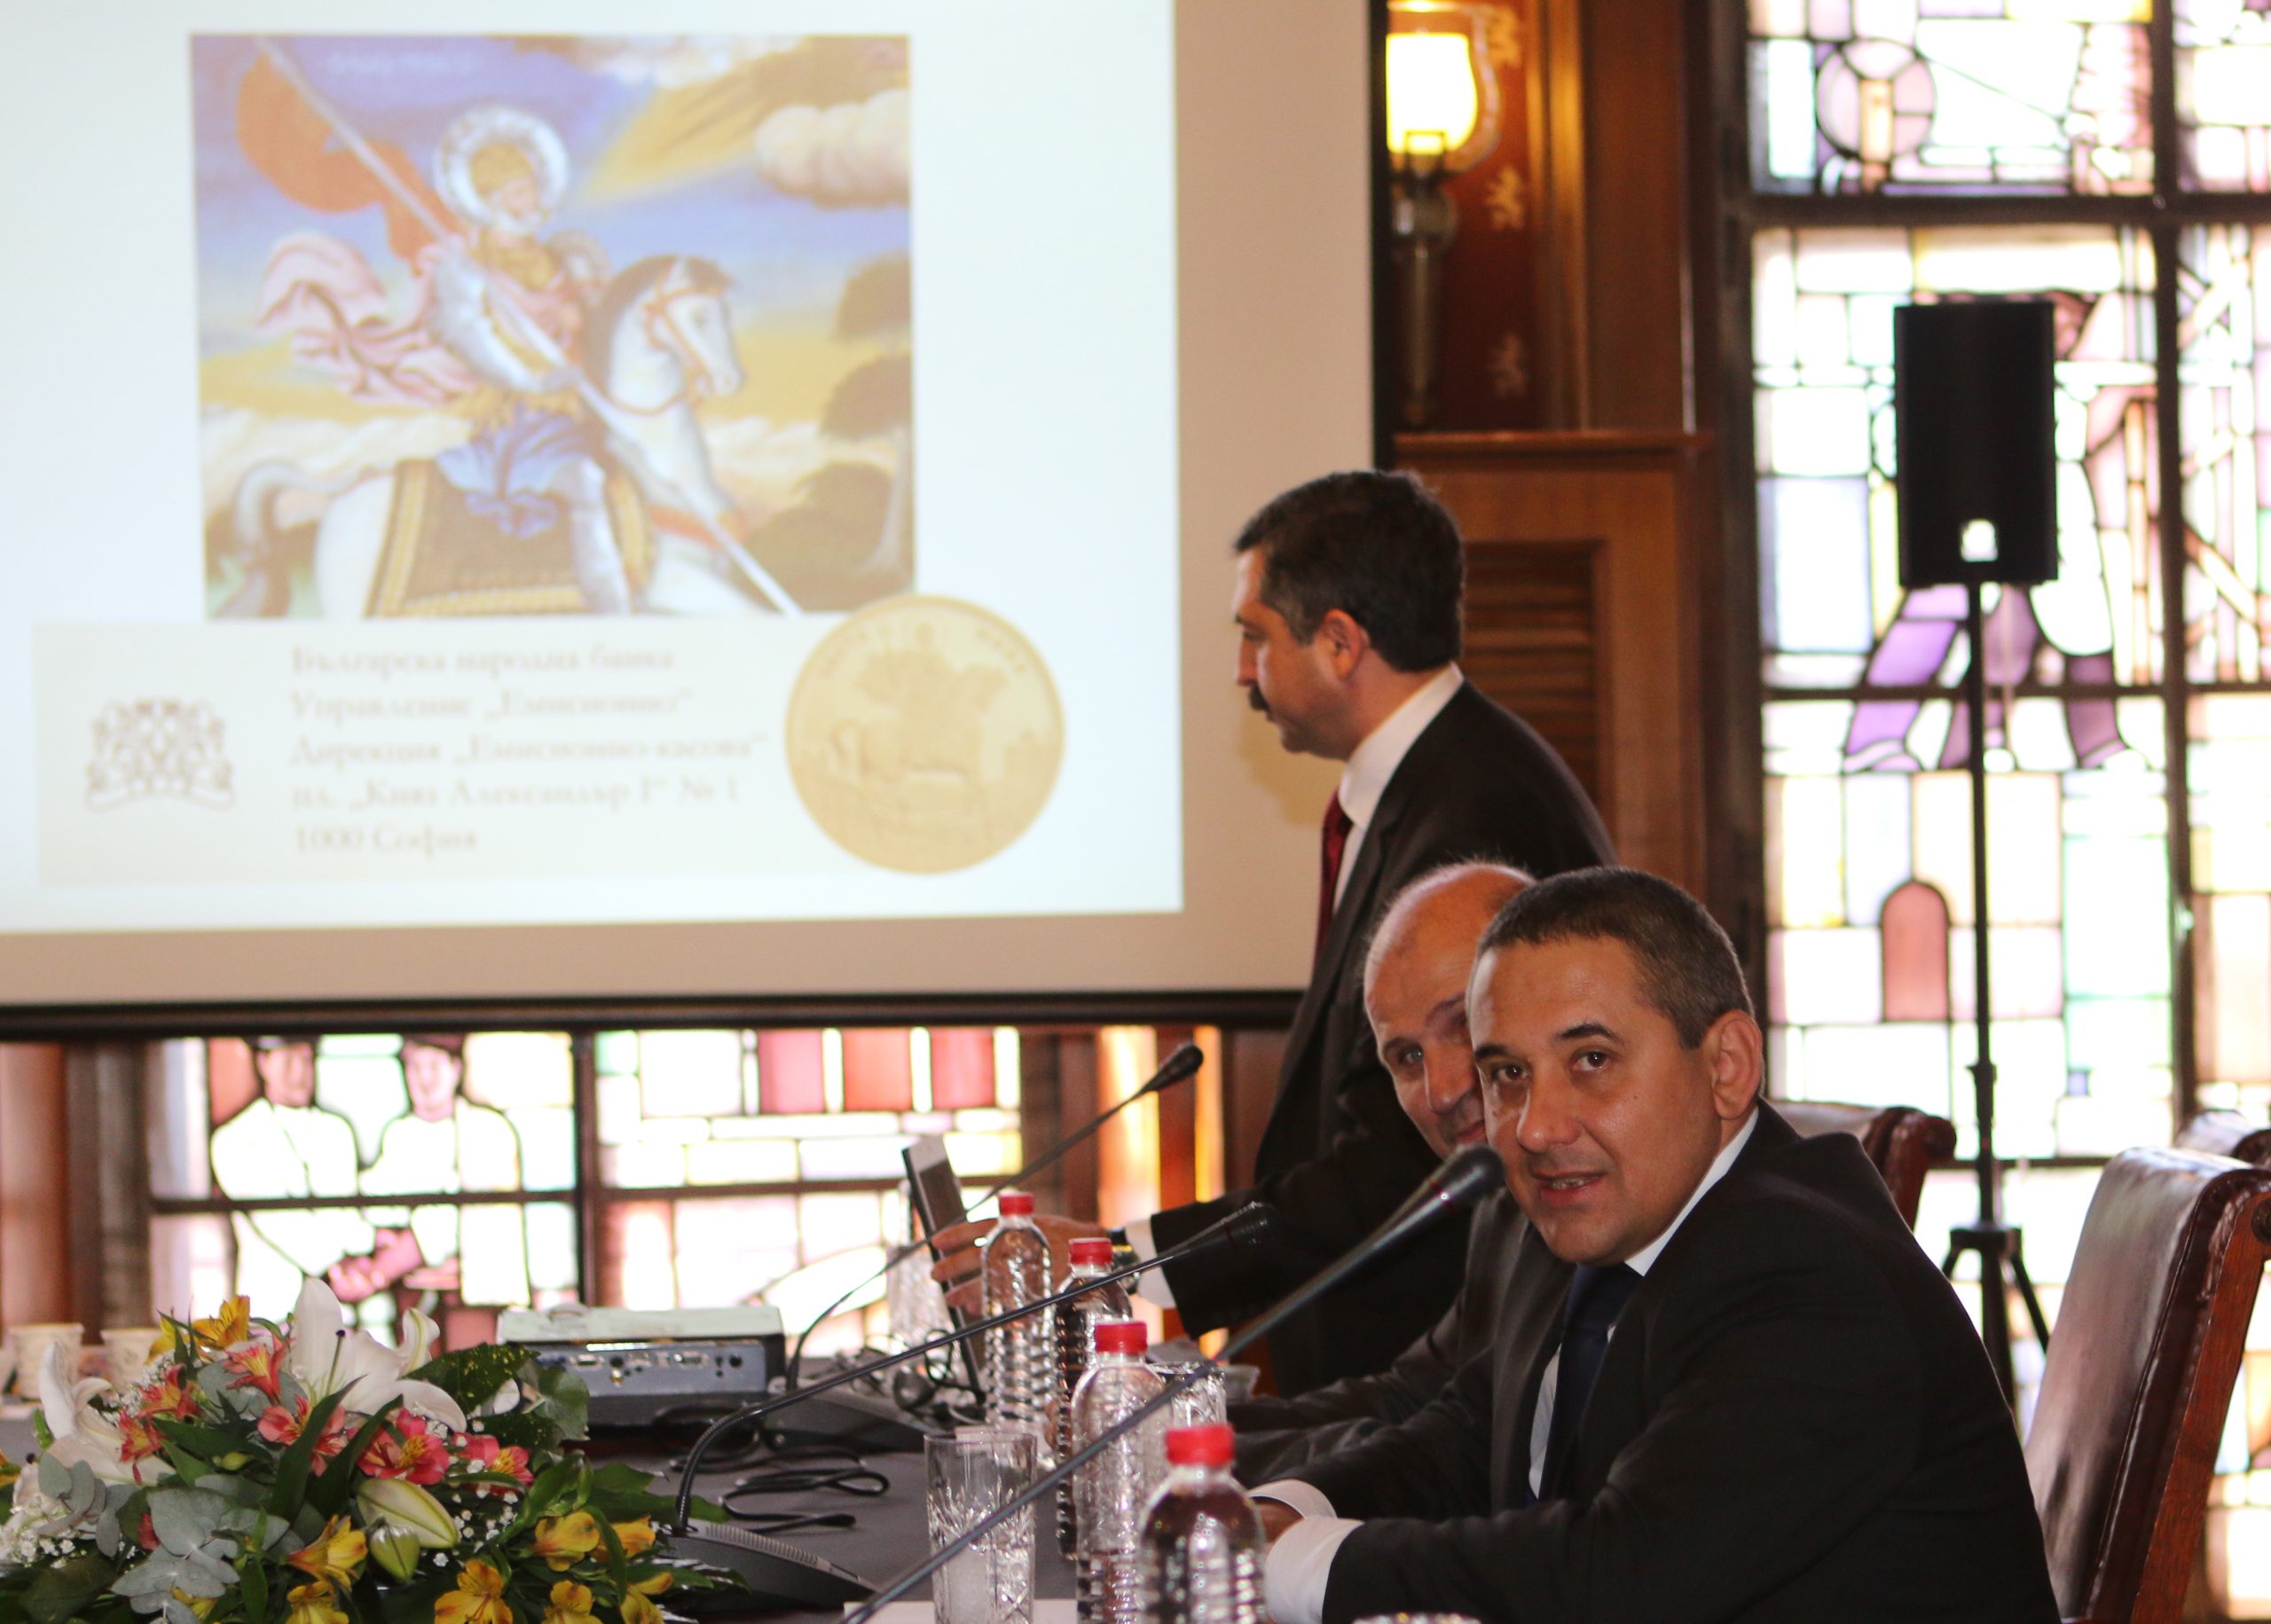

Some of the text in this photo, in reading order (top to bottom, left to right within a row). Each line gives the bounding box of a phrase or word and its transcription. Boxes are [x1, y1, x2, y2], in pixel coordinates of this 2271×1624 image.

[455, 651, 579, 680] народна
[588, 640, 675, 669] банка
[725, 772, 738, 803] 1
[296, 824, 479, 859] 1000 София
